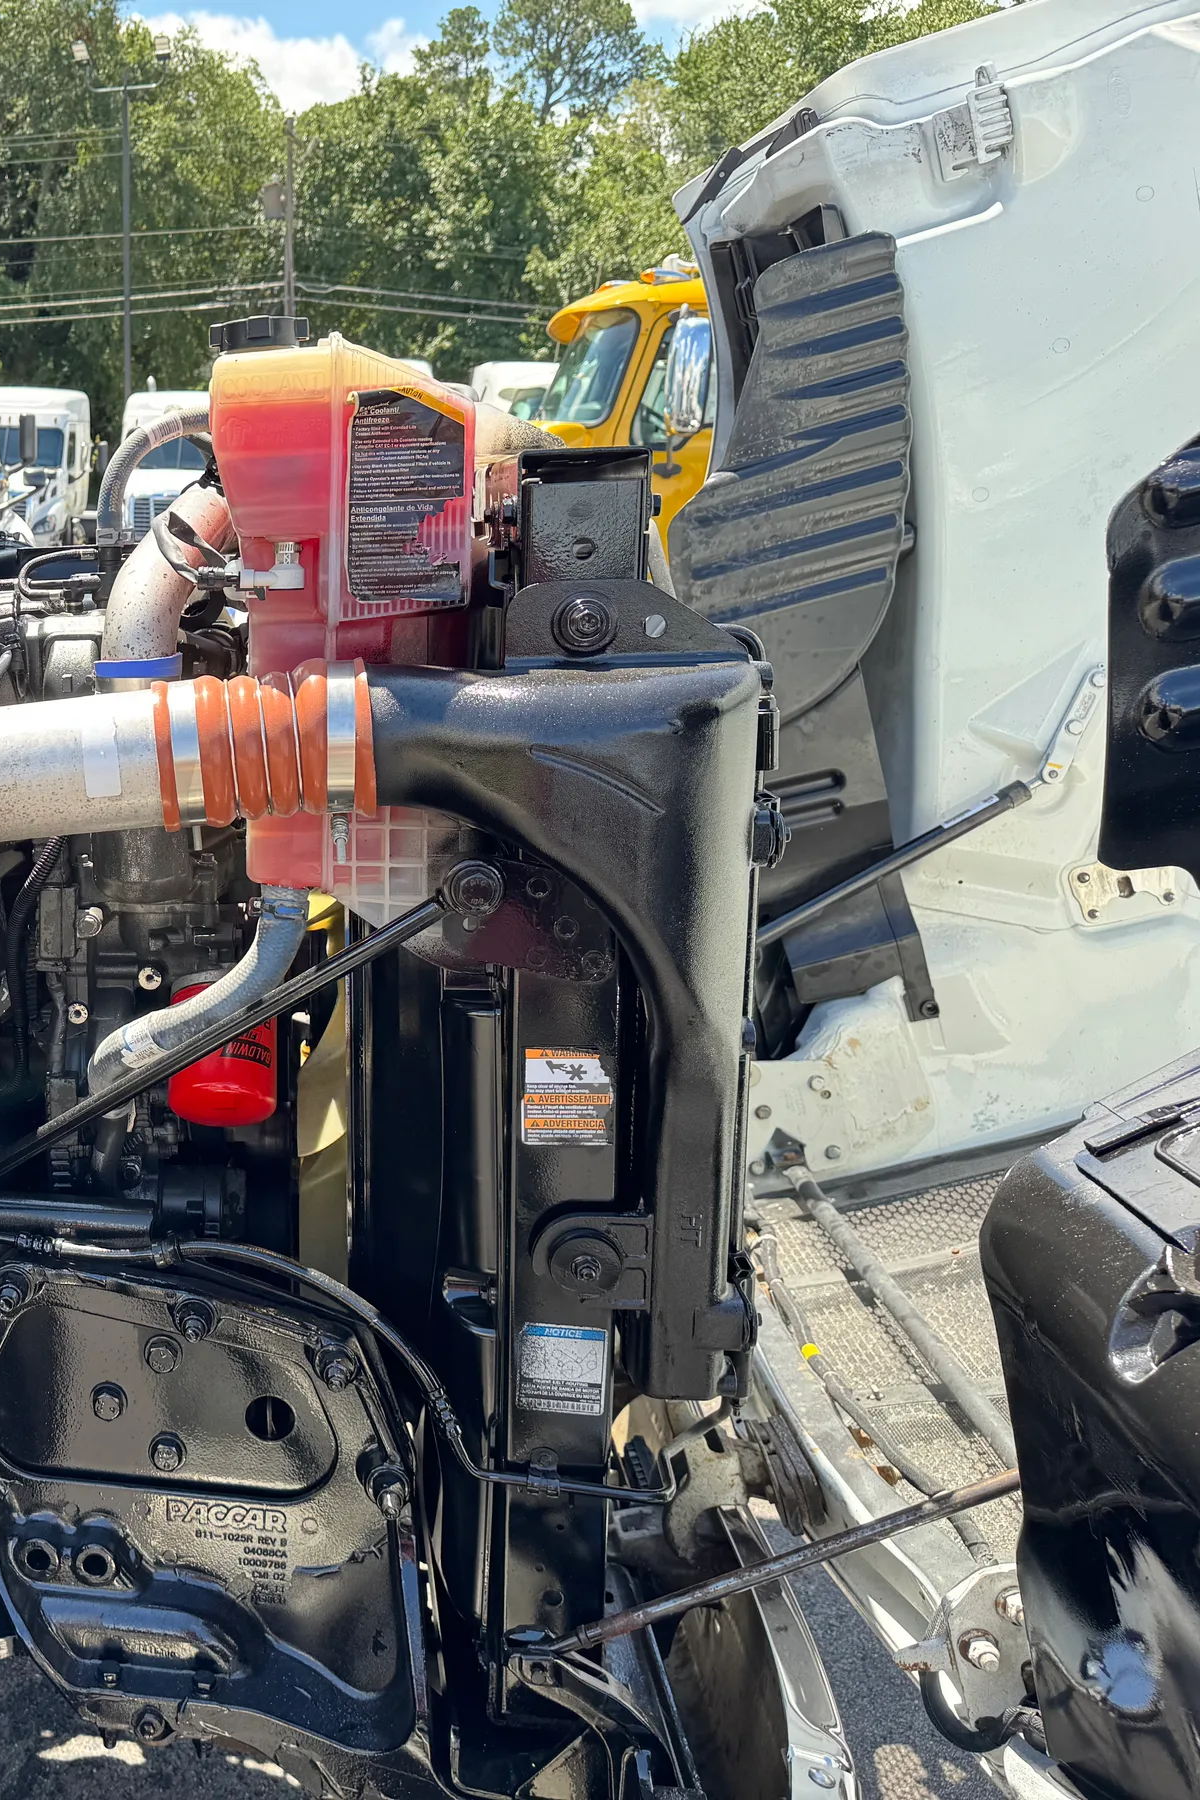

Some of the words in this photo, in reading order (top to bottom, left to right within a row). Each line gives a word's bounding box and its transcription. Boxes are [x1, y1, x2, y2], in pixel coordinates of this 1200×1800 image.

[221, 372, 326, 400] COOLANT
[370, 406, 400, 415] Coolant/
[354, 417, 391, 425] Antifreeze
[351, 505, 405, 514] Anticongelante
[417, 504, 434, 512] Vida
[351, 515, 387, 523] Extendida
[226, 1042, 271, 1064] BALDWIN
[538, 1095, 608, 1103] AVERTISSEMENT
[543, 1120, 605, 1128] ADVERTENCIA
[544, 1328, 583, 1338] NOTICE
[165, 1498, 287, 1534] PACCAR
[257, 1536, 277, 1547] REV
[280, 1538, 288, 1547] B
[243, 1546, 288, 1559] 04088CA
[252, 1570, 269, 1580] CMI
[273, 1573, 286, 1581] 02
